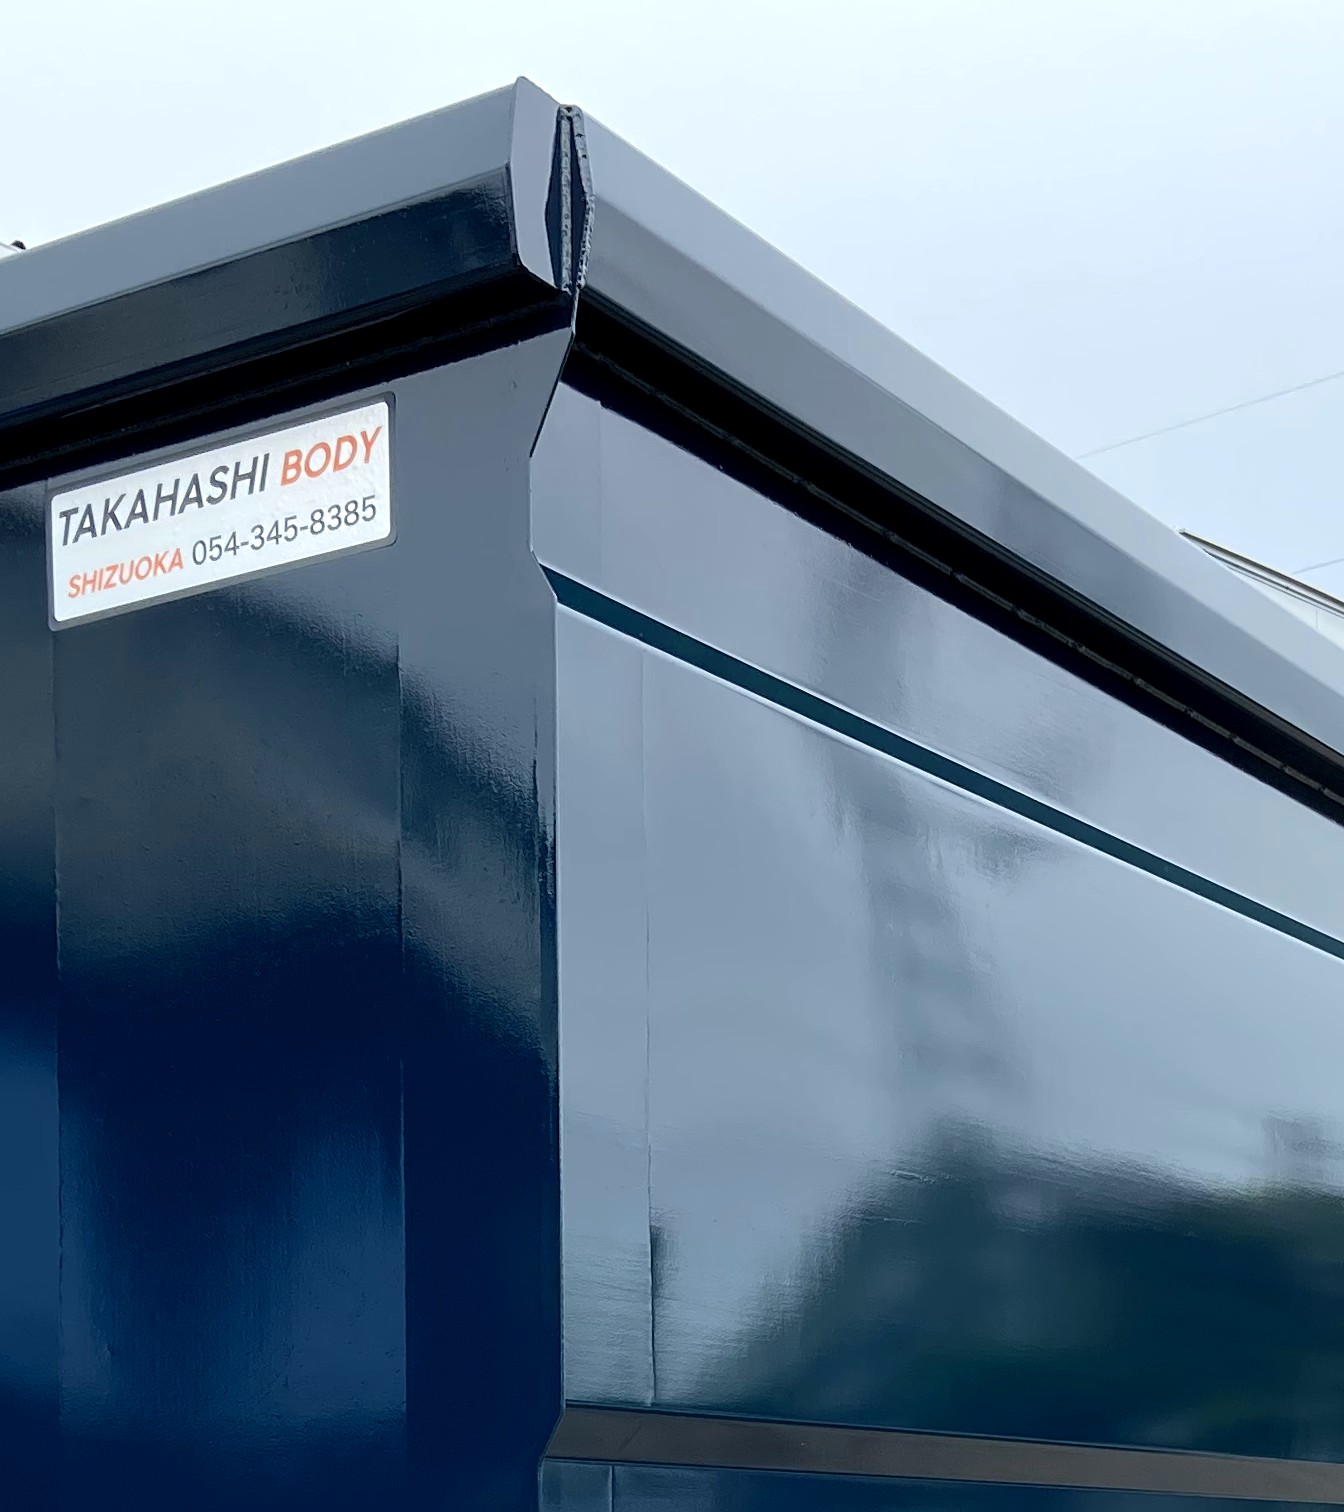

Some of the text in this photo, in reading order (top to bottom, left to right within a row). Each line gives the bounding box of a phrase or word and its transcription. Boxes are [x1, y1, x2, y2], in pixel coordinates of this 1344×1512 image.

[59, 426, 382, 546] TAKAHASHI BODY
[67, 495, 377, 598] SHIZUOKA 054-345-8385
